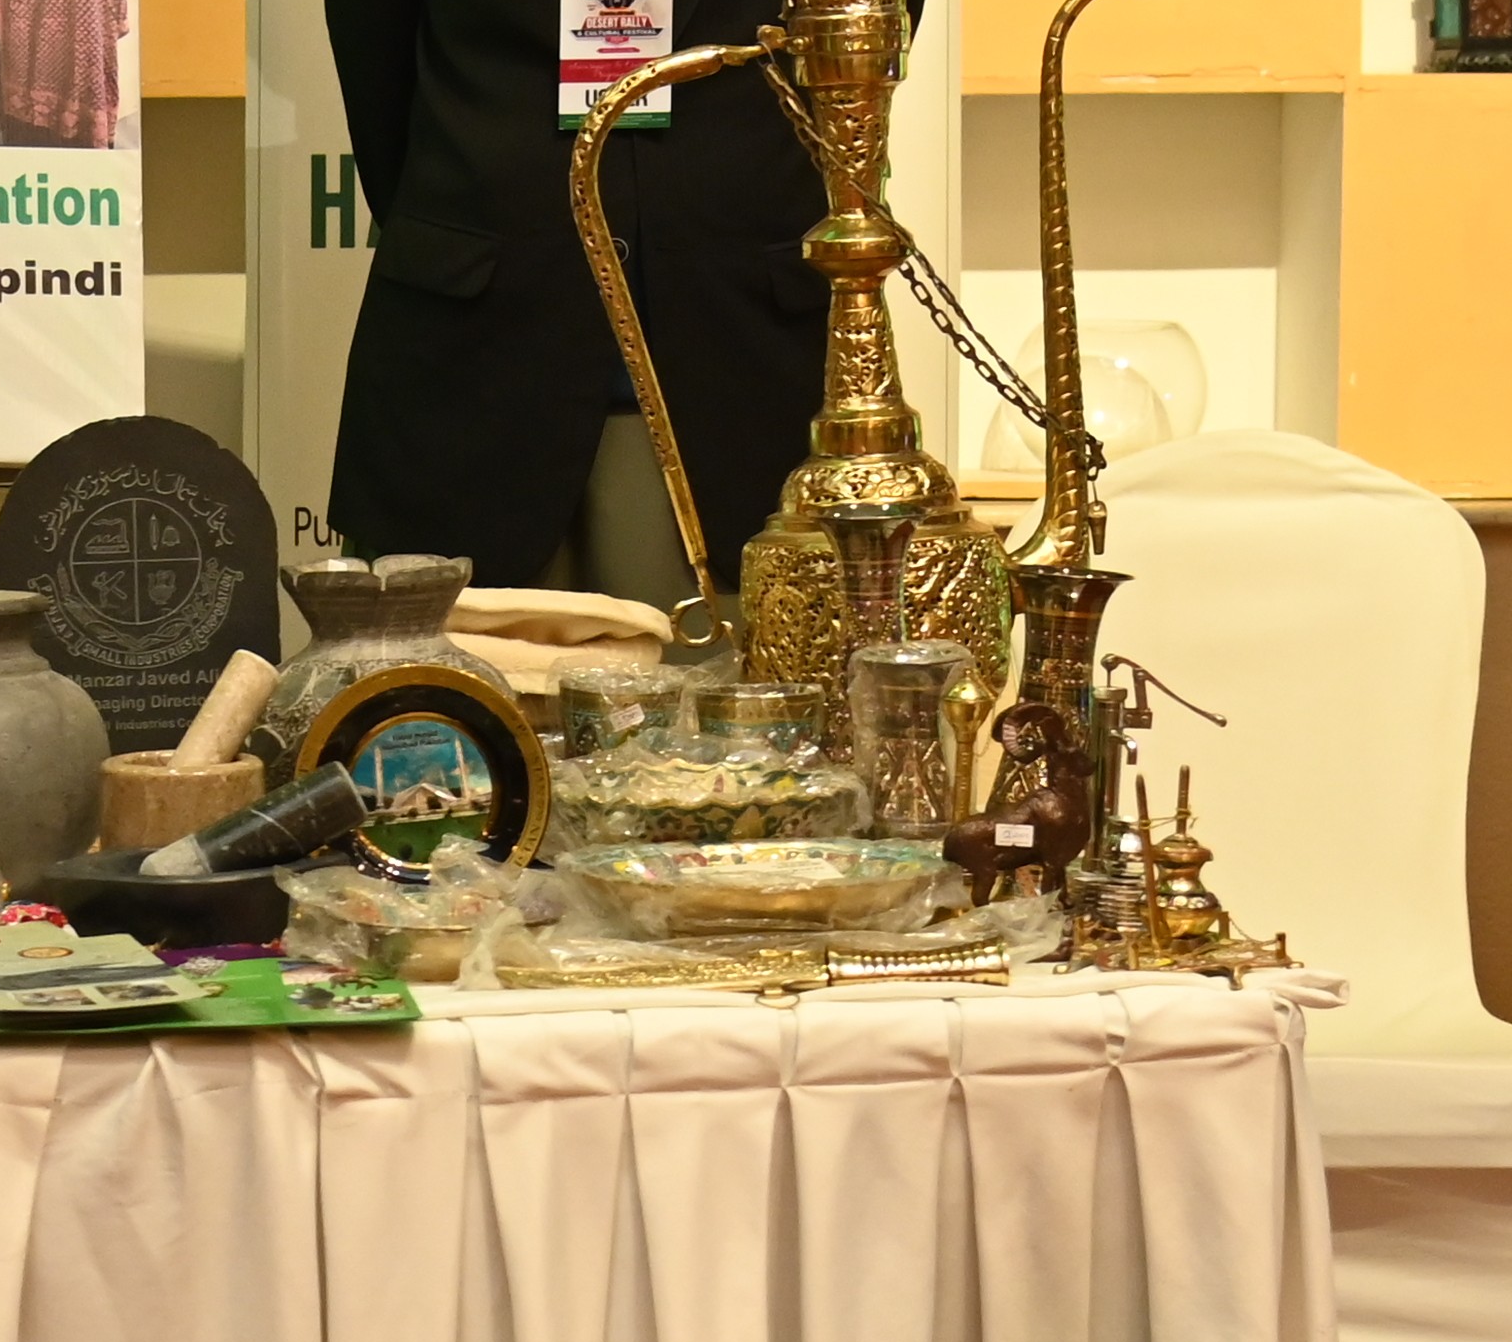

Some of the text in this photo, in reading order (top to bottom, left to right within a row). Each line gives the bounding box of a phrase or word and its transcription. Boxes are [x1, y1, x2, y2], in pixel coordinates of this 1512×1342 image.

[586, 17, 618, 29] DESERT
[82, 641, 122, 664] SMALL
[124, 639, 194, 665] INDUSTRIES
[196, 573, 233, 639] CORPORATION
[137, 671, 190, 686] Javed
[151, 694, 206, 709] Directo
